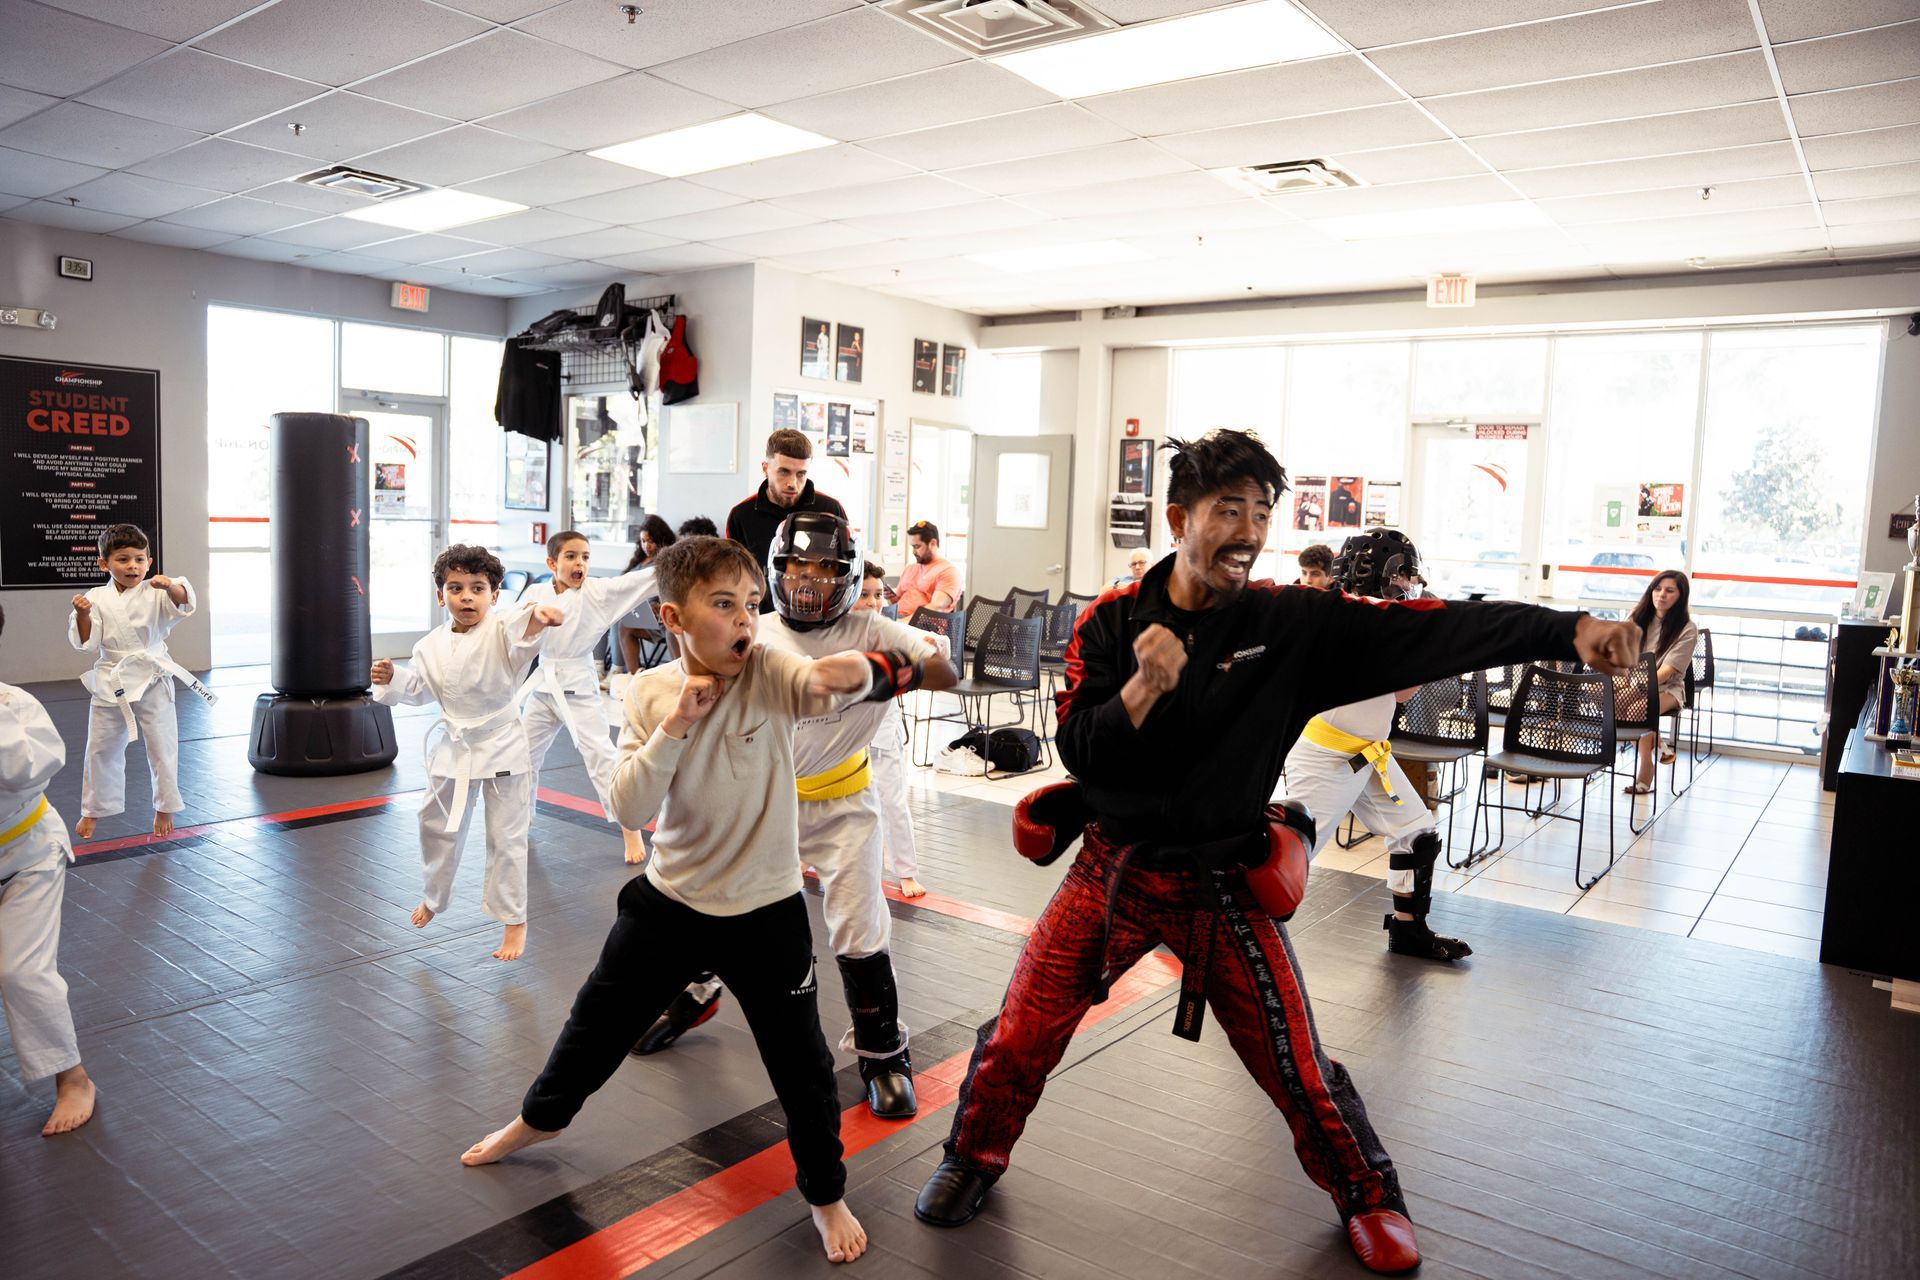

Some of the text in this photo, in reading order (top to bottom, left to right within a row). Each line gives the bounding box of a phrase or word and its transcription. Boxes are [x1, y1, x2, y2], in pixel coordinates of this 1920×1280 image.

[400, 285, 424, 308] EXIT
[1435, 279, 1467, 304] EXIT
[55, 376, 102, 385] CHAMPIONSHIP
[29, 390, 129, 412] STUDENT
[26, 409, 130, 437] CREED
[190, 680, 213, 701] Arturo
